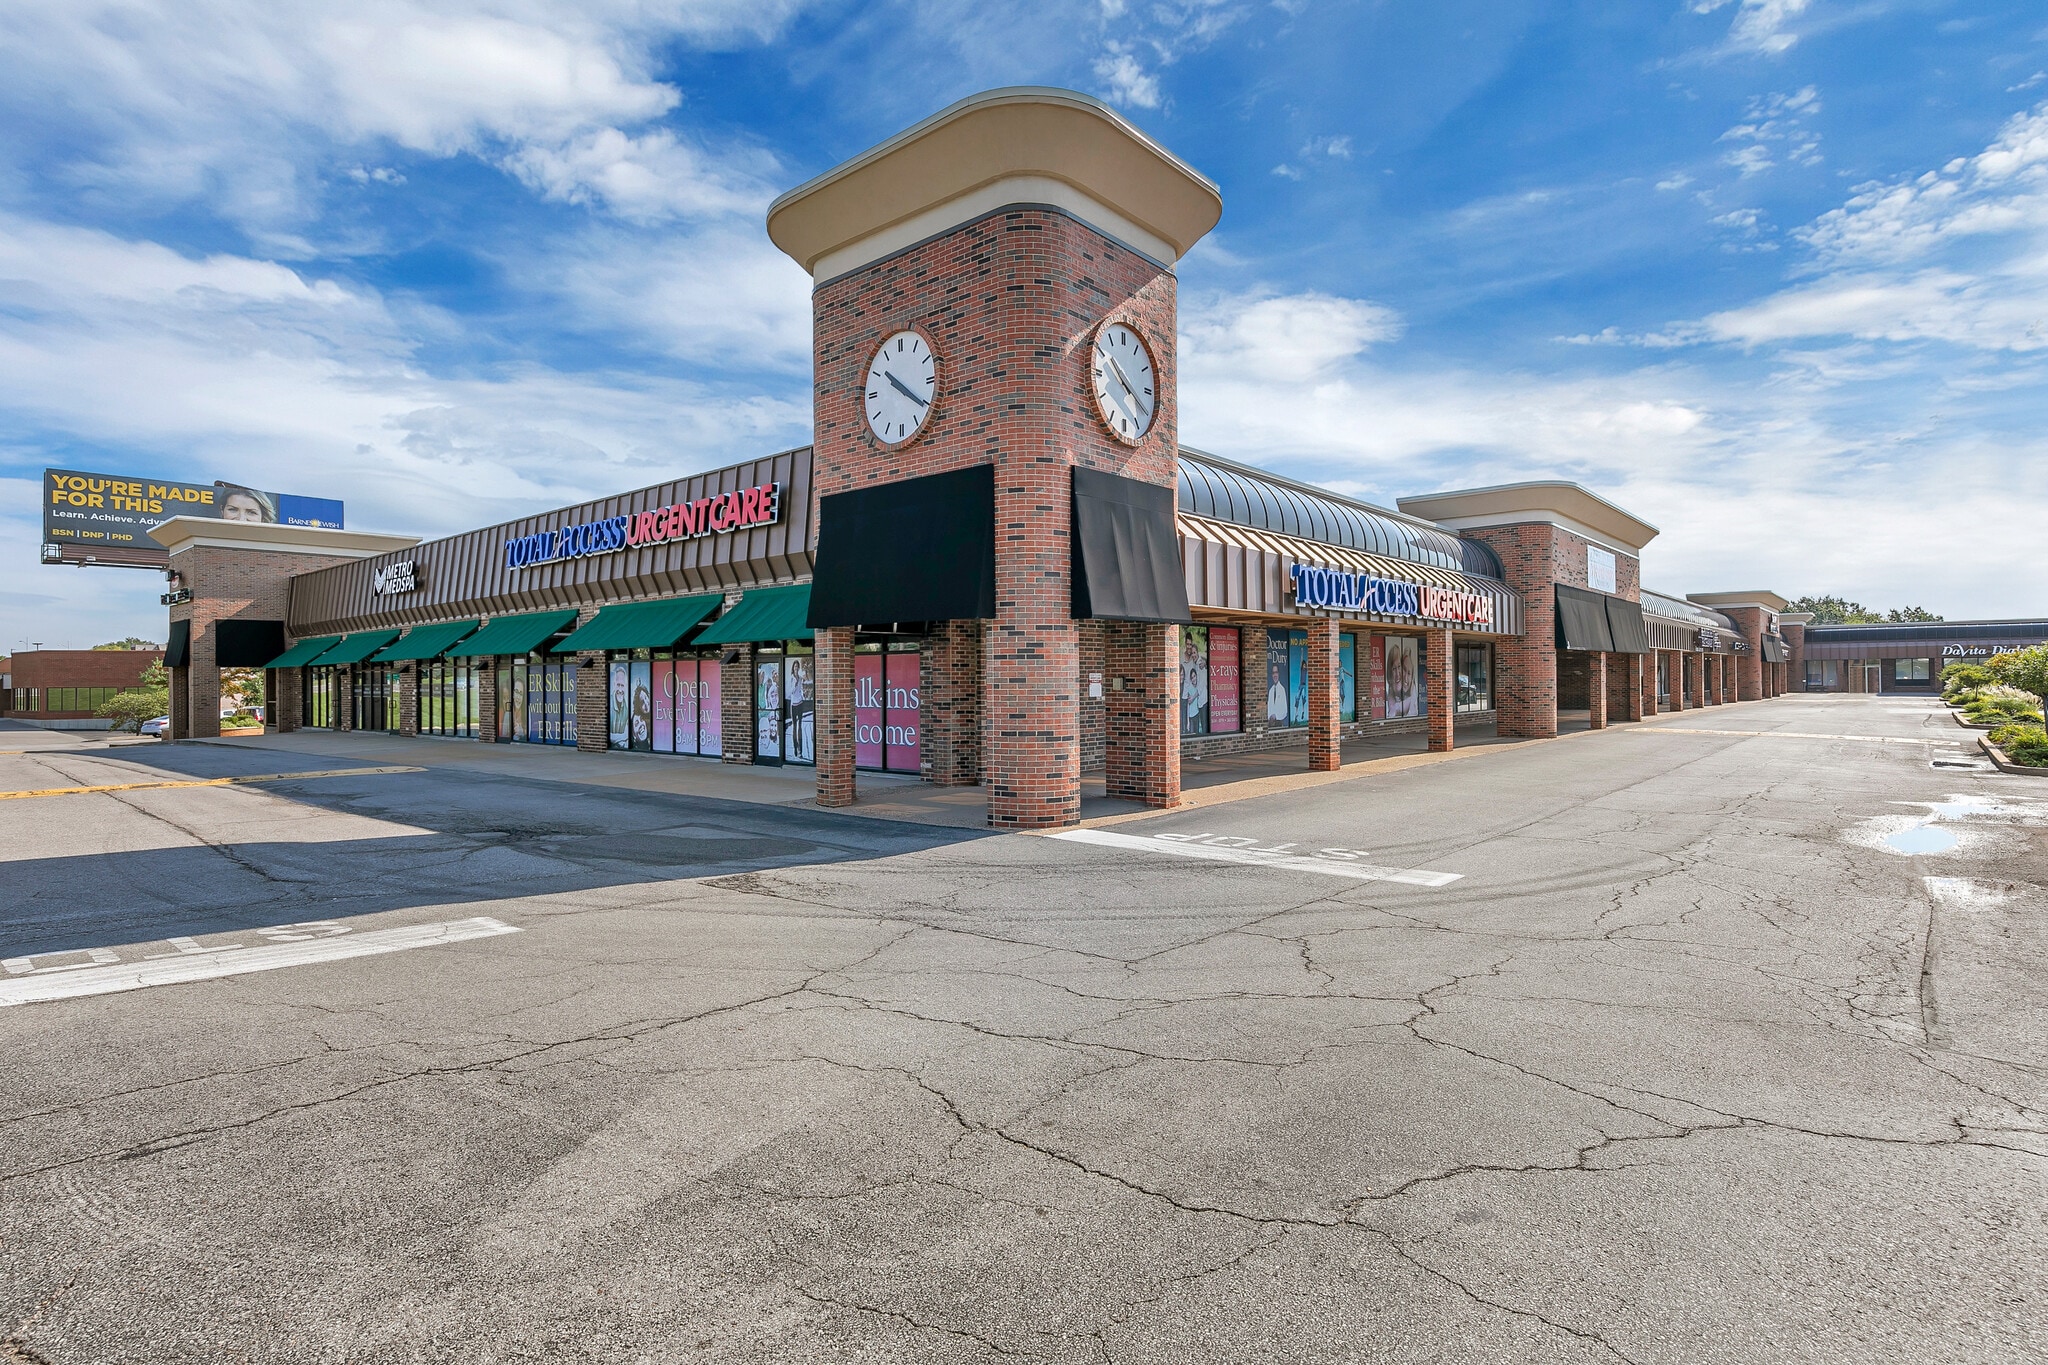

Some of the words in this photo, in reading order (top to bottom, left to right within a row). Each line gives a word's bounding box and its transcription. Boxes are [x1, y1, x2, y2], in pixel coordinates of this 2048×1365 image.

[51, 474, 143, 497] YOU'RE
[148, 484, 214, 504] MADE
[51, 490, 105, 509] FOR
[109, 495, 164, 514] THIS
[52, 509, 88, 520] Learn.
[90, 512, 137, 524] Achieve.
[505, 532, 557, 569] TOTAL
[554, 516, 627, 559] ACCESS
[626, 498, 711, 546] URGENT
[708, 483, 777, 531] CARE
[52, 528, 74, 537] BSN
[82, 530, 104, 539] DNP
[111, 533, 133, 541] PHD
[386, 560, 413, 580] METRO
[385, 575, 415, 595] MEDSPA
[1294, 564, 1357, 608] TOTAL
[1360, 574, 1418, 616] ACCESS
[1418, 585, 1467, 620] URGENT
[1466, 594, 1494, 624] CARE
[1209, 640, 1216, 651] &
[1266, 635, 1287, 650] Doctor
[1941, 643, 1987, 657] DaVita
[1272, 651, 1288, 666] Duty
[529, 674, 543, 692] ER
[545, 672, 575, 692] Skills
[1210, 665, 1238, 680] x-rays
[663, 671, 710, 706] Open
[1210, 680, 1237, 692] Pharmacy
[1210, 693, 1238, 709] Physicals
[538, 720, 553, 740] ER
[554, 720, 578, 741] Bills
[1153, 832, 1370, 860] STOP
